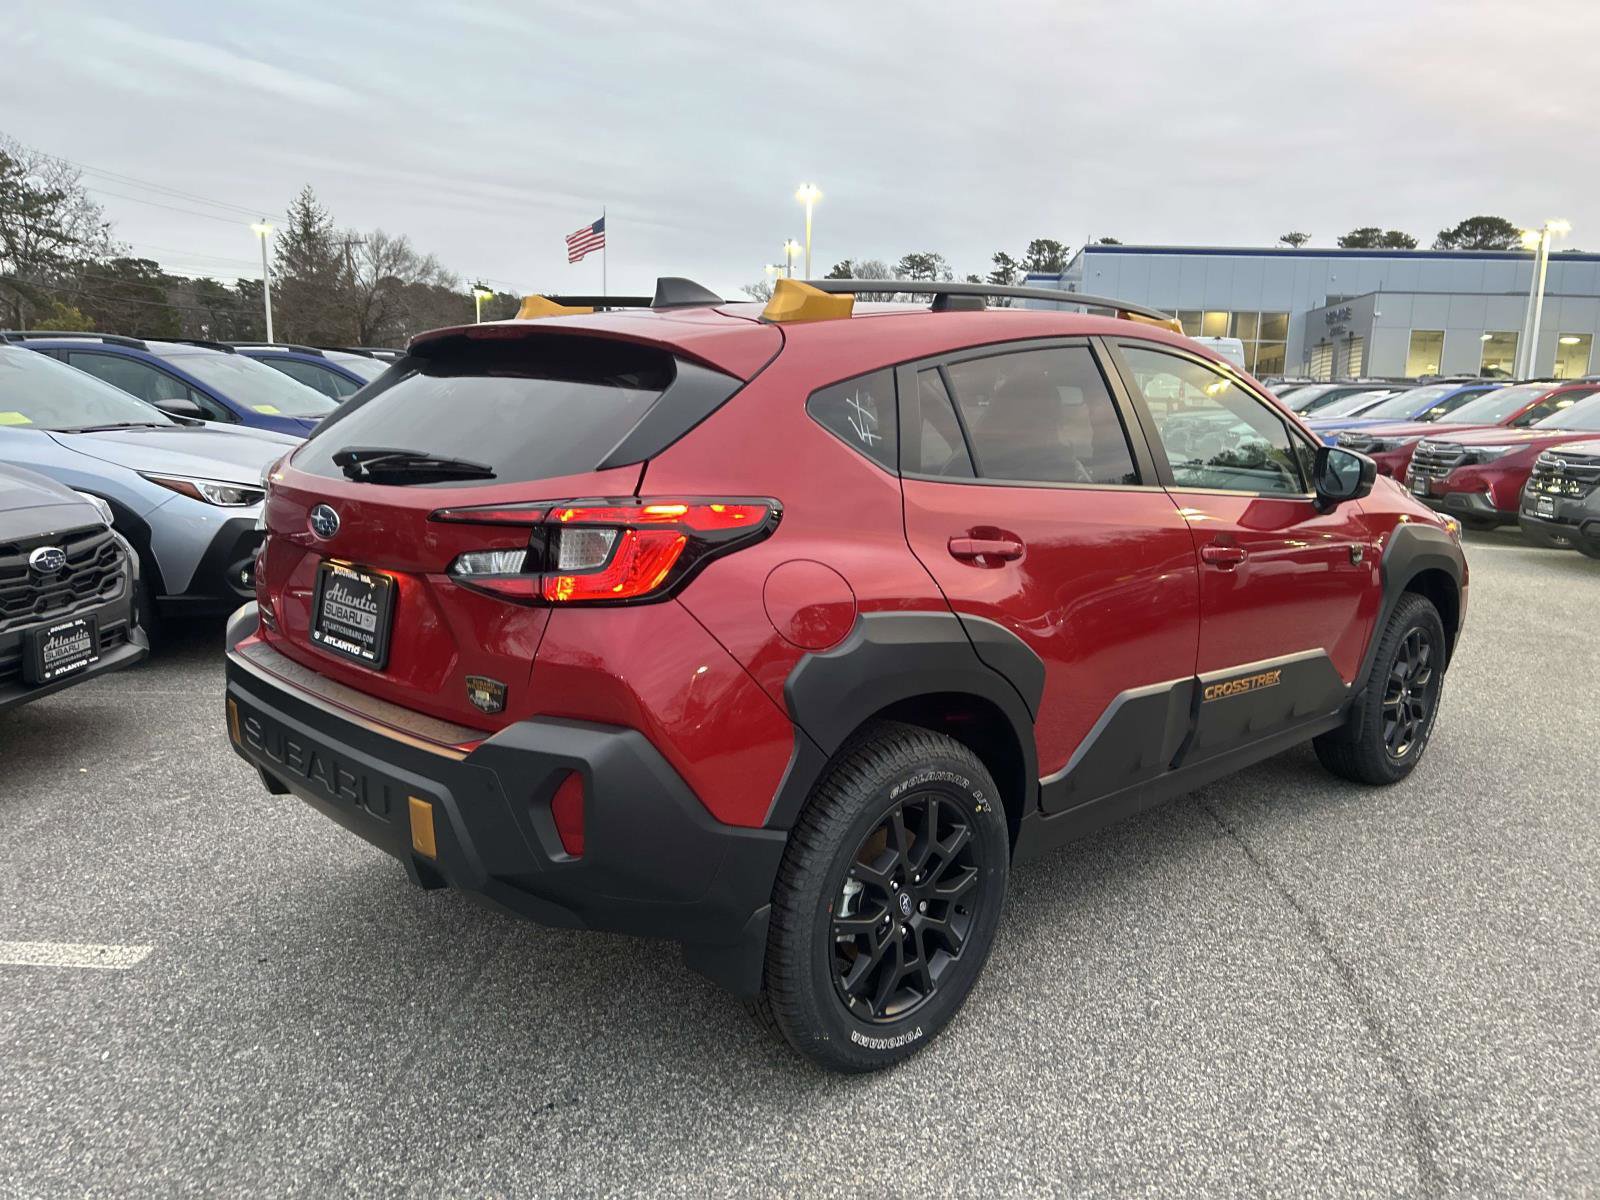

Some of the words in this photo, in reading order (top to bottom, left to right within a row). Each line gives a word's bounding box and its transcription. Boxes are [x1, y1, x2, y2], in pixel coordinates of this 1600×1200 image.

[326, 582, 378, 614] Atlantic
[325, 602, 363, 625] SUBARU
[43, 628, 90, 651] Atlantic
[45, 641, 80, 660] SUBARU
[1204, 669, 1282, 700] CROSSTREK
[244, 716, 392, 824] SUBARU
[851, 1026, 923, 1050] YOKOHAMA
